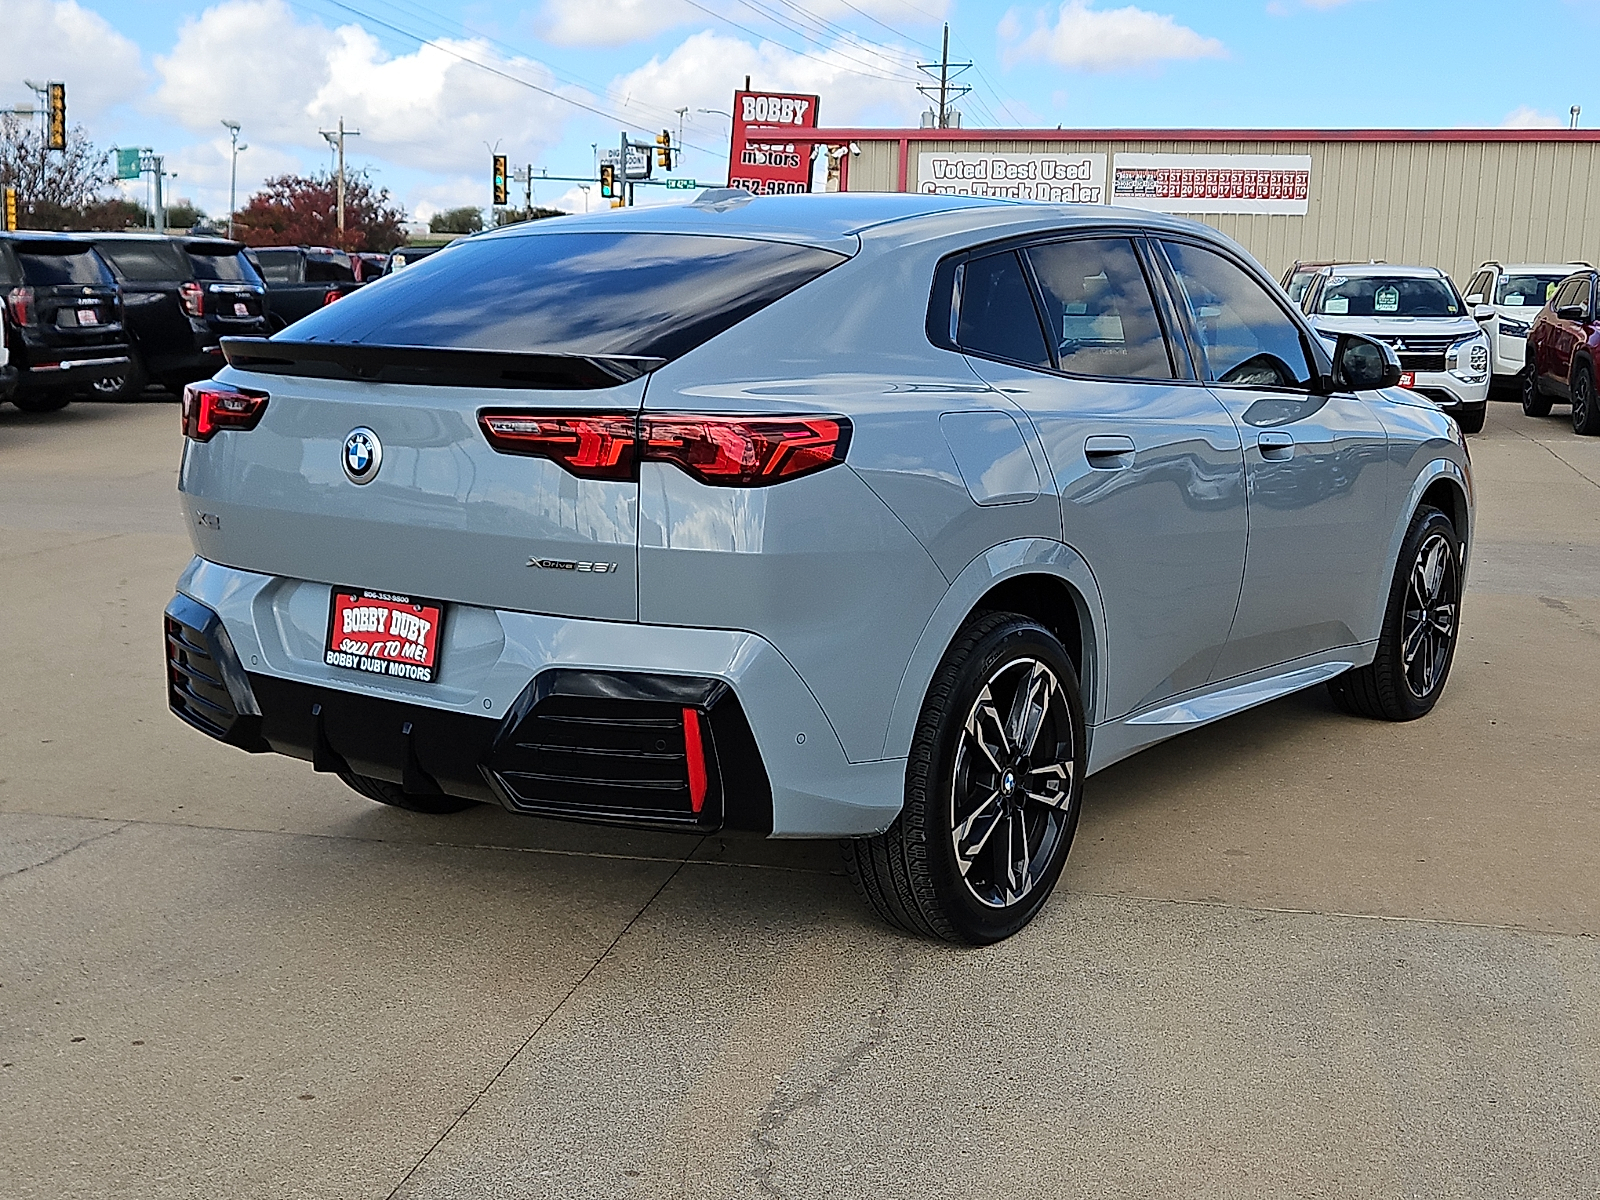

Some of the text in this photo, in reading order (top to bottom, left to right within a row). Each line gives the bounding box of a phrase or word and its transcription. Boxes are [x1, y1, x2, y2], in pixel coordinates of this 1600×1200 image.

[742, 96, 809, 125] BOBBY
[741, 151, 800, 168] motors
[932, 160, 1091, 180] Voted Best Used
[972, 182, 1032, 199] Truck
[1036, 183, 1101, 203] Dealer
[342, 606, 431, 645] BOBBY DUBY
[340, 638, 428, 663] SOLD IT TO ME!
[326, 651, 431, 681] BOBBY DUBY MOTORS
